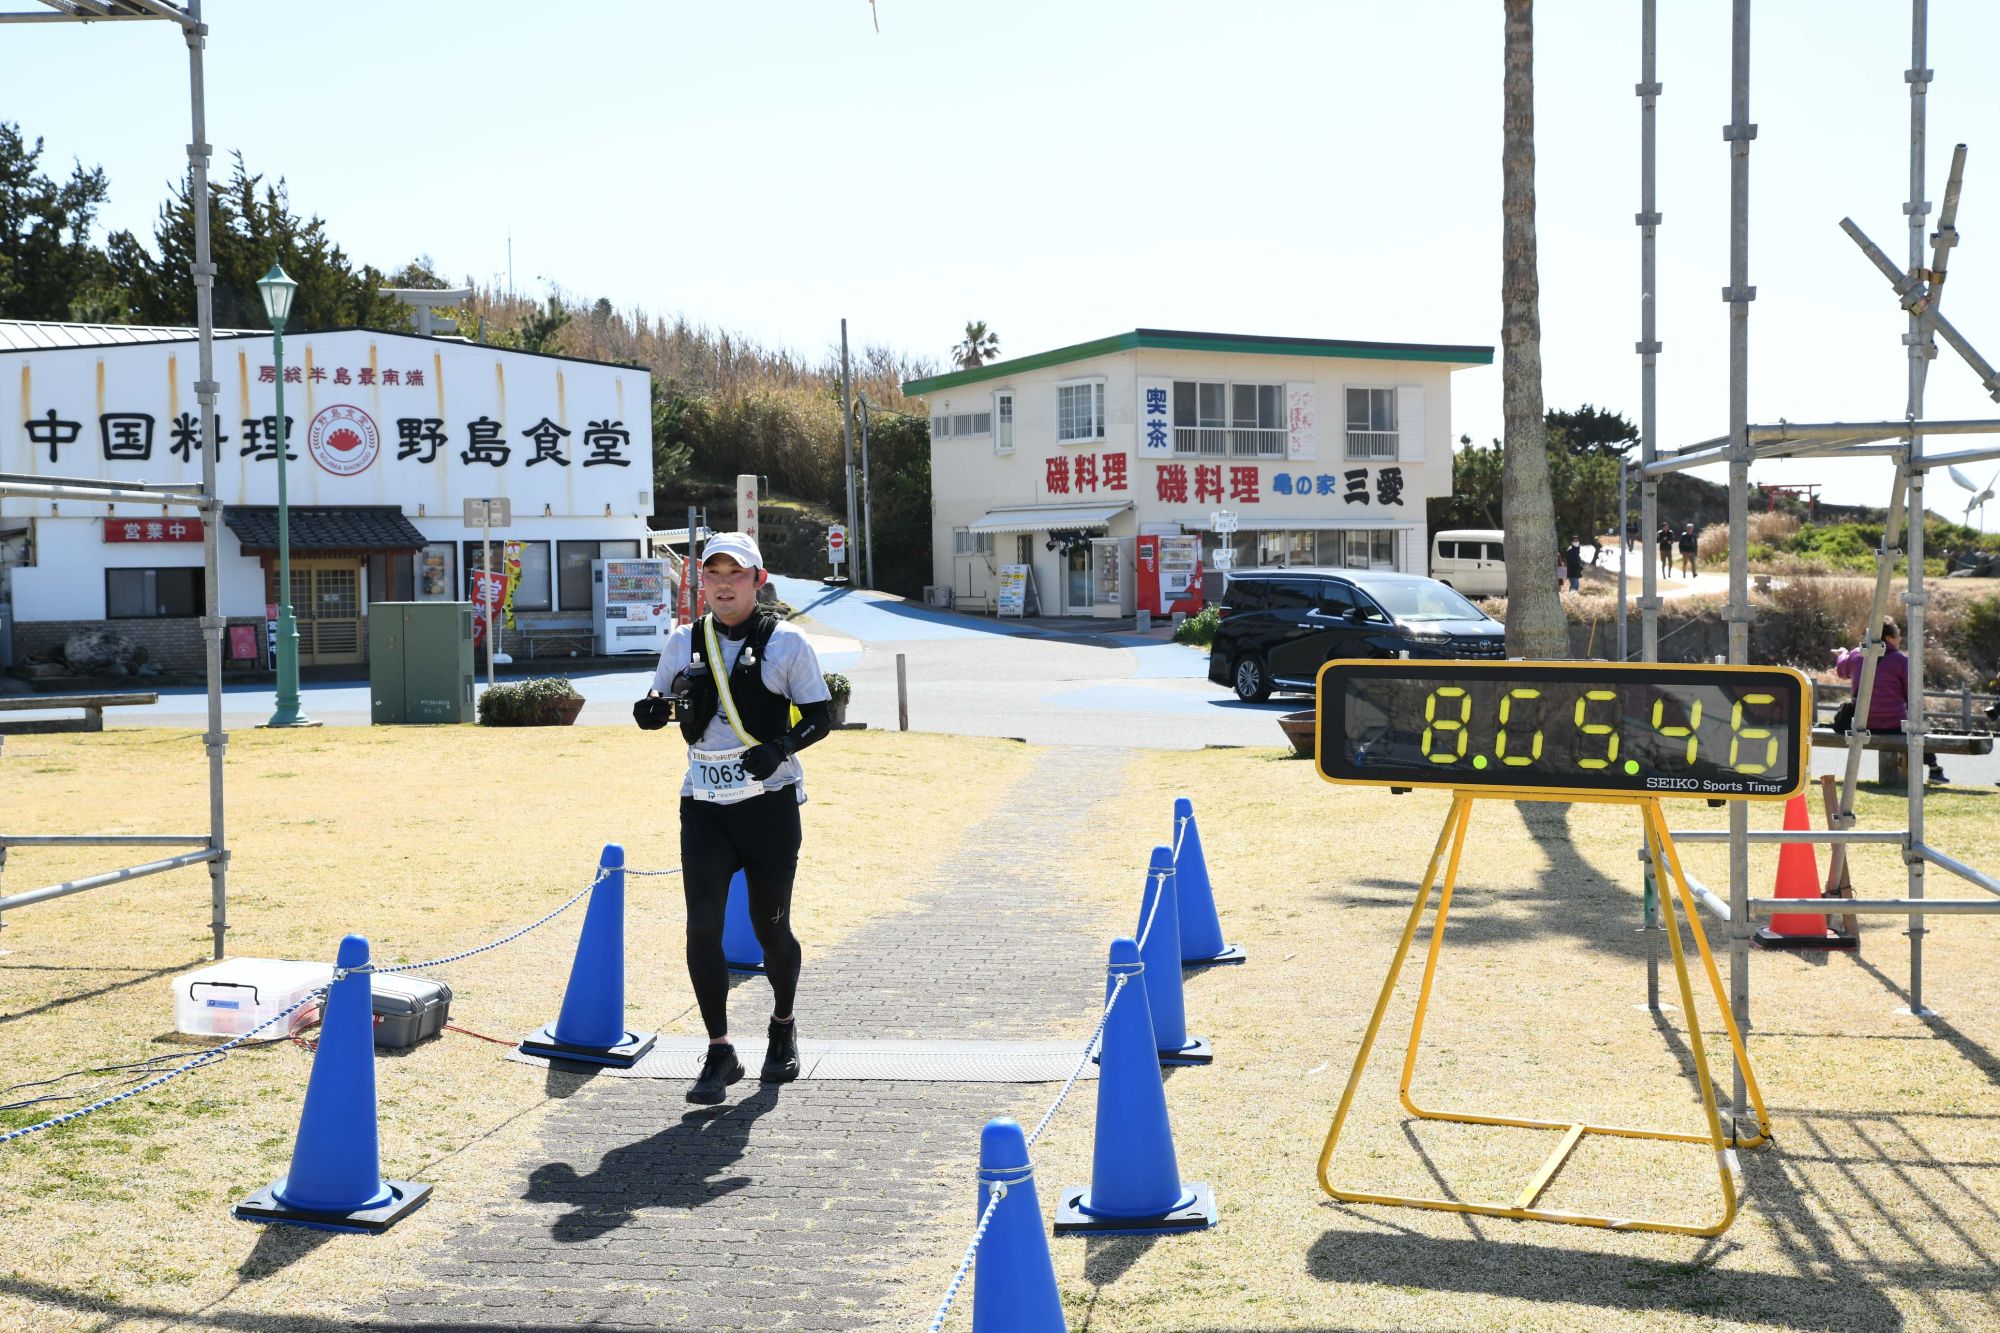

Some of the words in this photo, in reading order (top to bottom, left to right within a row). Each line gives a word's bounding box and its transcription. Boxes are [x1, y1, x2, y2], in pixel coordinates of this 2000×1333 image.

[258, 365, 425, 387] 房総半島最南端
[1146, 387, 1167, 449] 喫茶
[24, 409, 298, 463] 中国料理
[396, 415, 631, 467] 野島食堂
[1045, 452, 1128, 494] 磯料理
[1156, 464, 1260, 504] 磯料理
[1273, 472, 1335, 496] 亀の家
[1343, 466, 1404, 506] 三愛
[124, 522, 186, 540] 営業中
[700, 763, 745, 784] 7063
[1646, 777, 1699, 790] SEIKO
[1703, 780, 1743, 792] Sports
[1747, 781, 1782, 793] Timer
